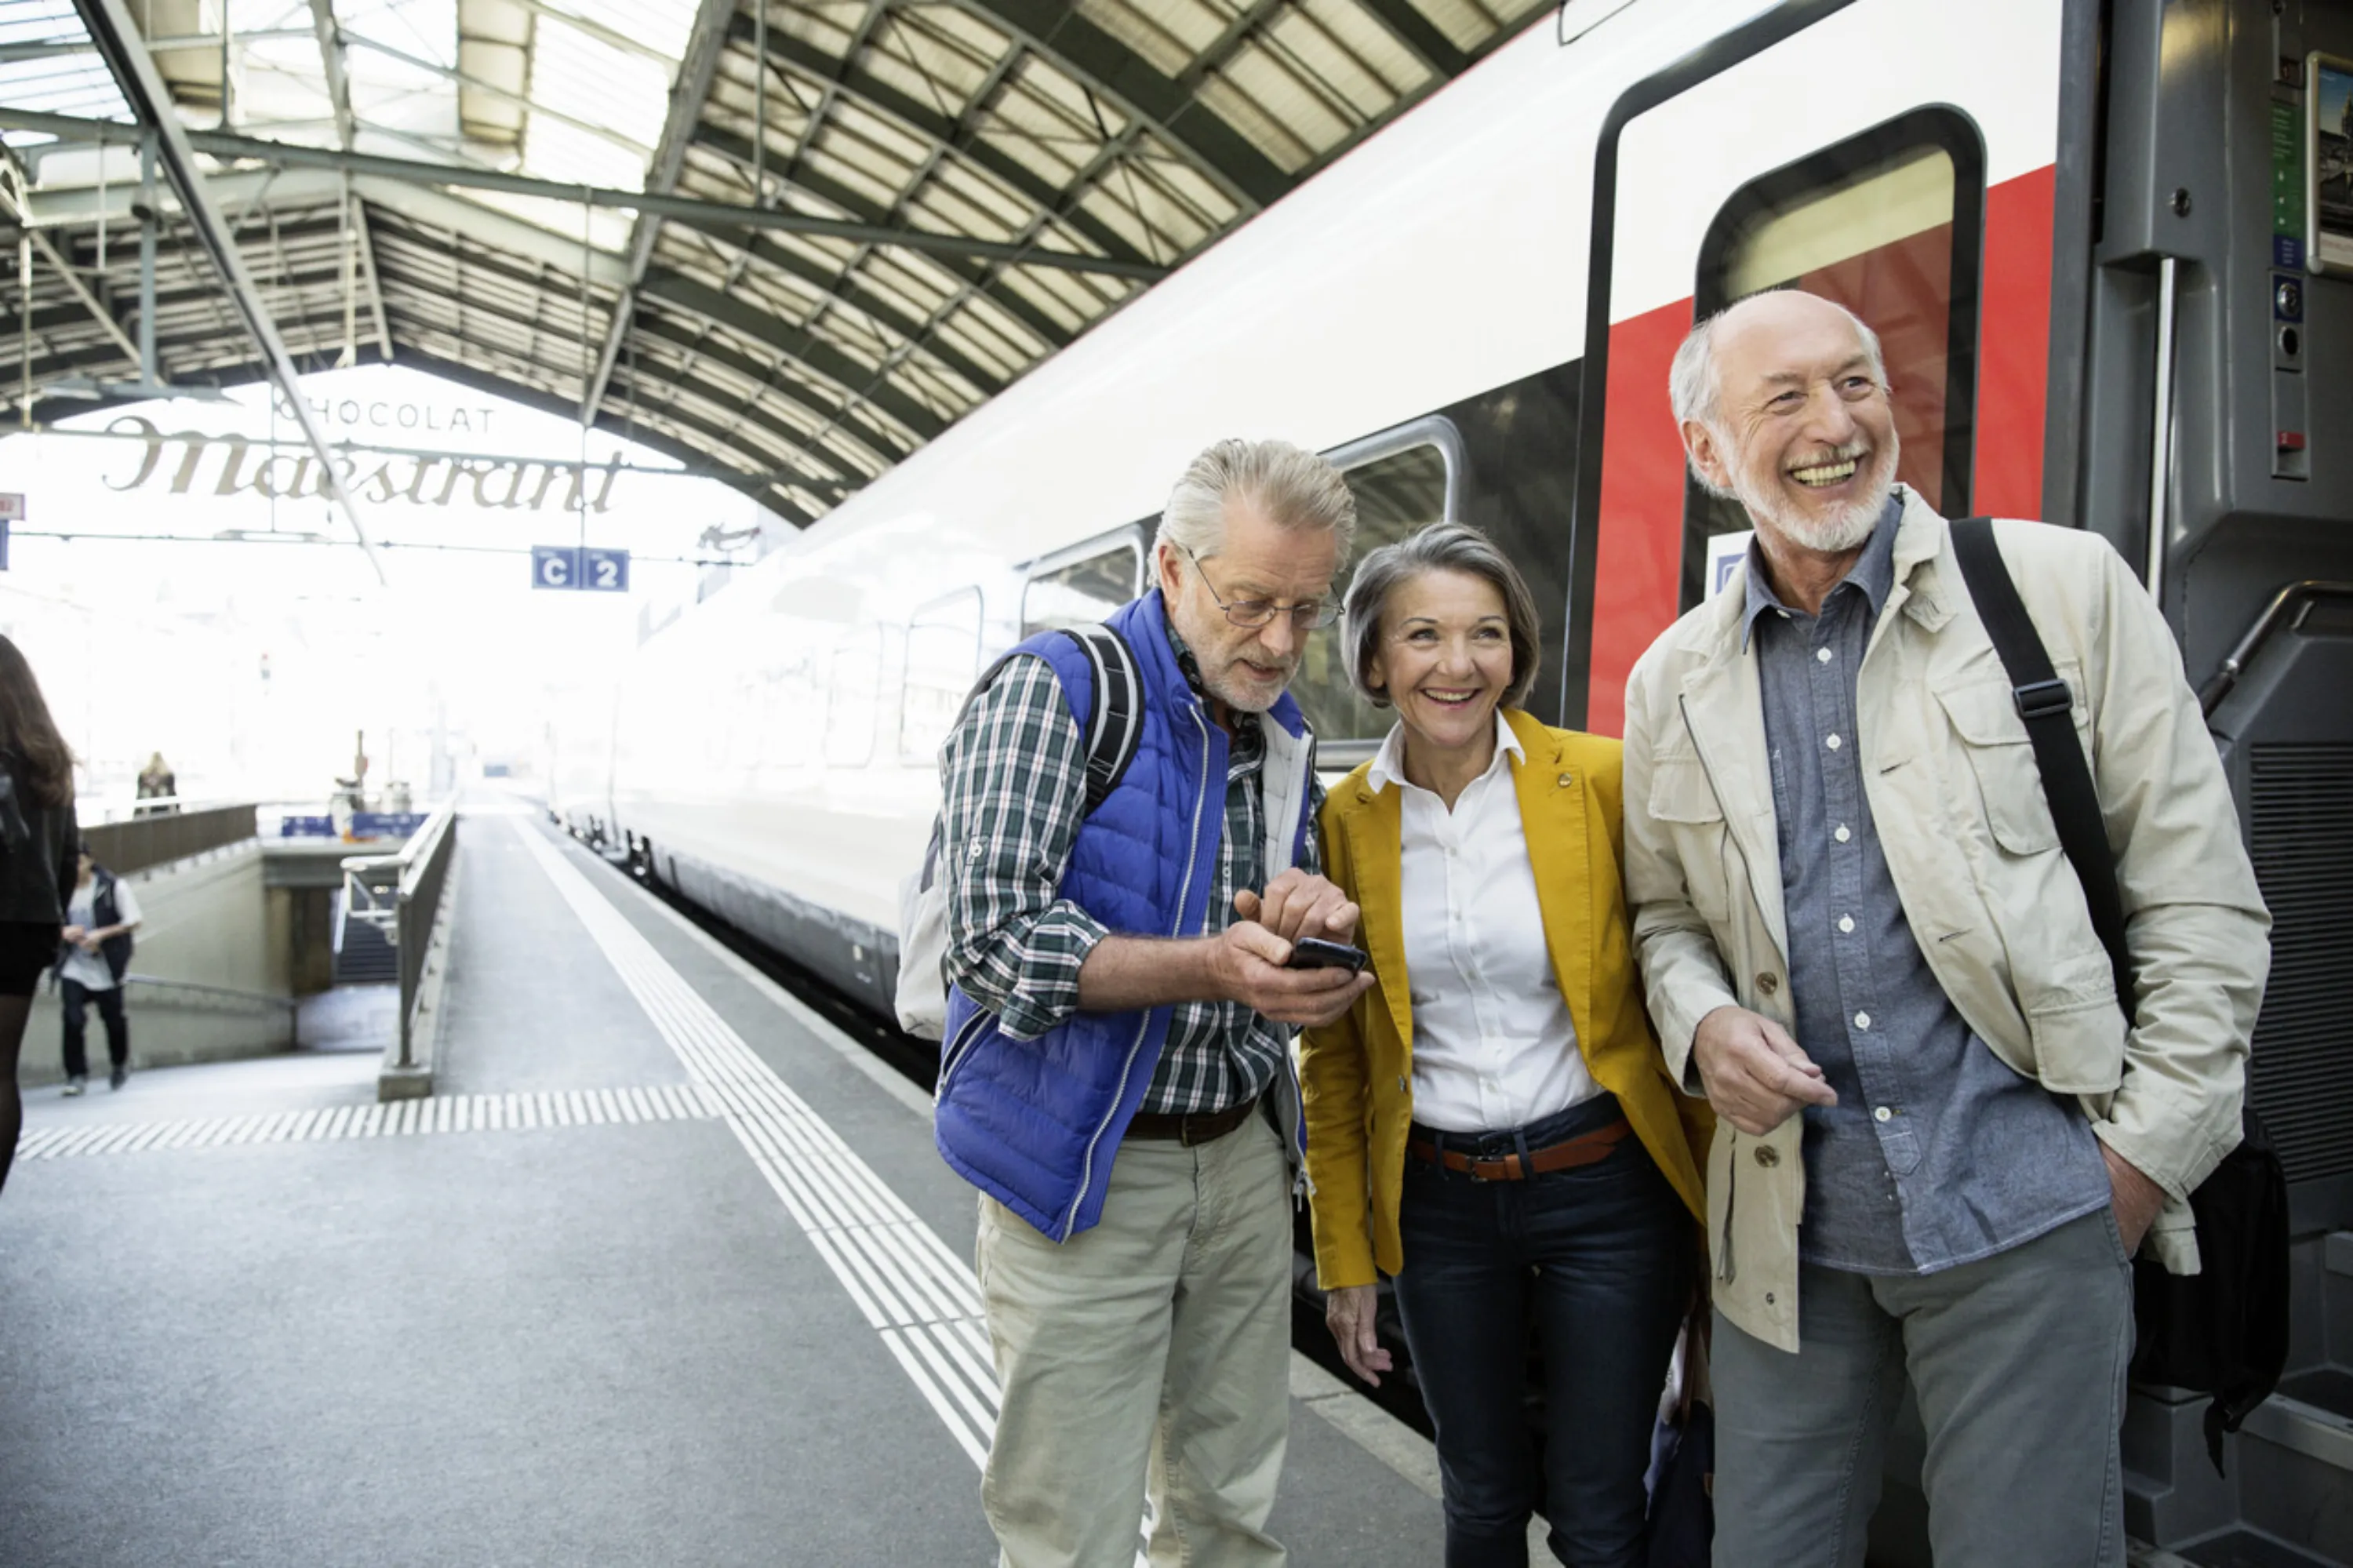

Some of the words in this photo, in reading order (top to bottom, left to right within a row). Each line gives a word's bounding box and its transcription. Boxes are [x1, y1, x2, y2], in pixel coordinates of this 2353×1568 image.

[279, 397, 496, 433] CHOCOLAT
[101, 414, 622, 513] Maestrant
[543, 557, 567, 585] C
[596, 558, 618, 588] 2
